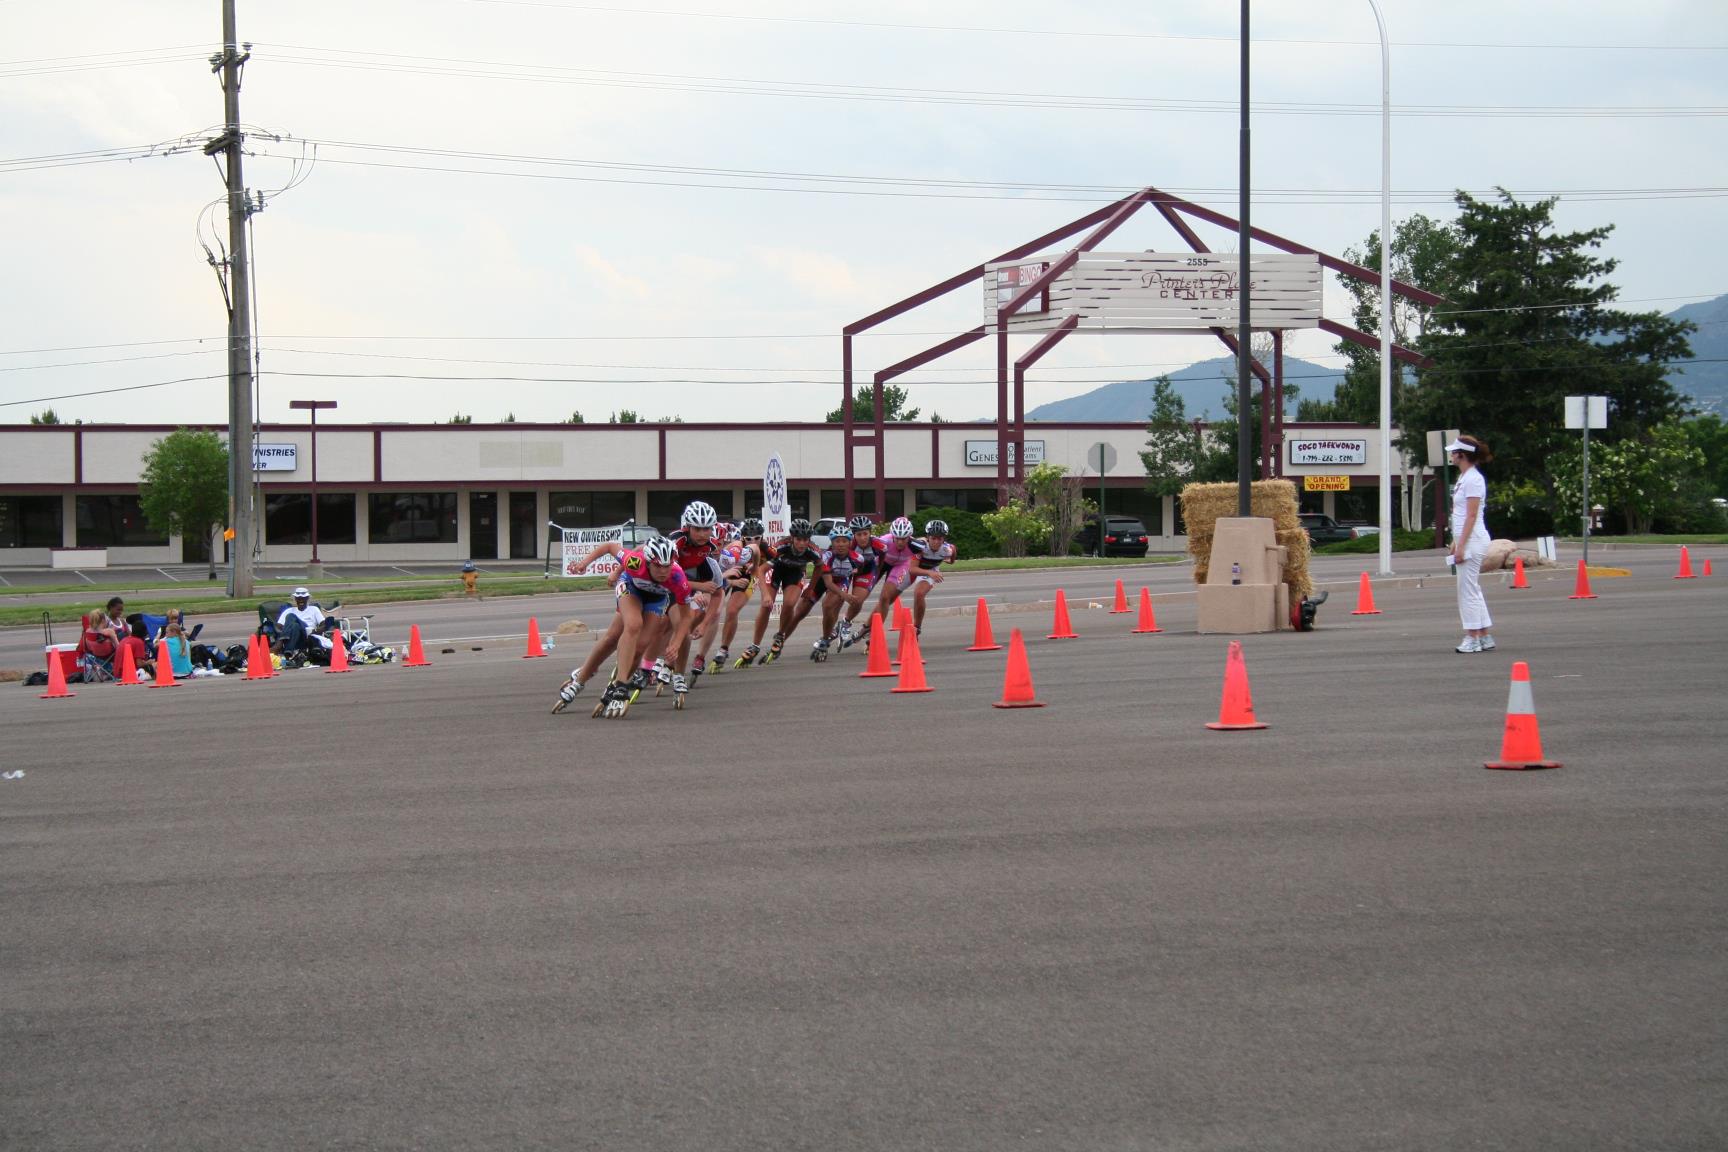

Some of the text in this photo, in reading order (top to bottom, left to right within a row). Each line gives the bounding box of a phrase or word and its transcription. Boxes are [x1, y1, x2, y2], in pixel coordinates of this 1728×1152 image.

[1187, 258, 1208, 266] 2555
[1210, 272, 1257, 290] Plae
[1160, 291, 1233, 299] CENTER
[1319, 442, 1360, 451] TAEKWONDO
[564, 529, 621, 543] NEW OWNERSHIP
[565, 545, 590, 555] FREE
